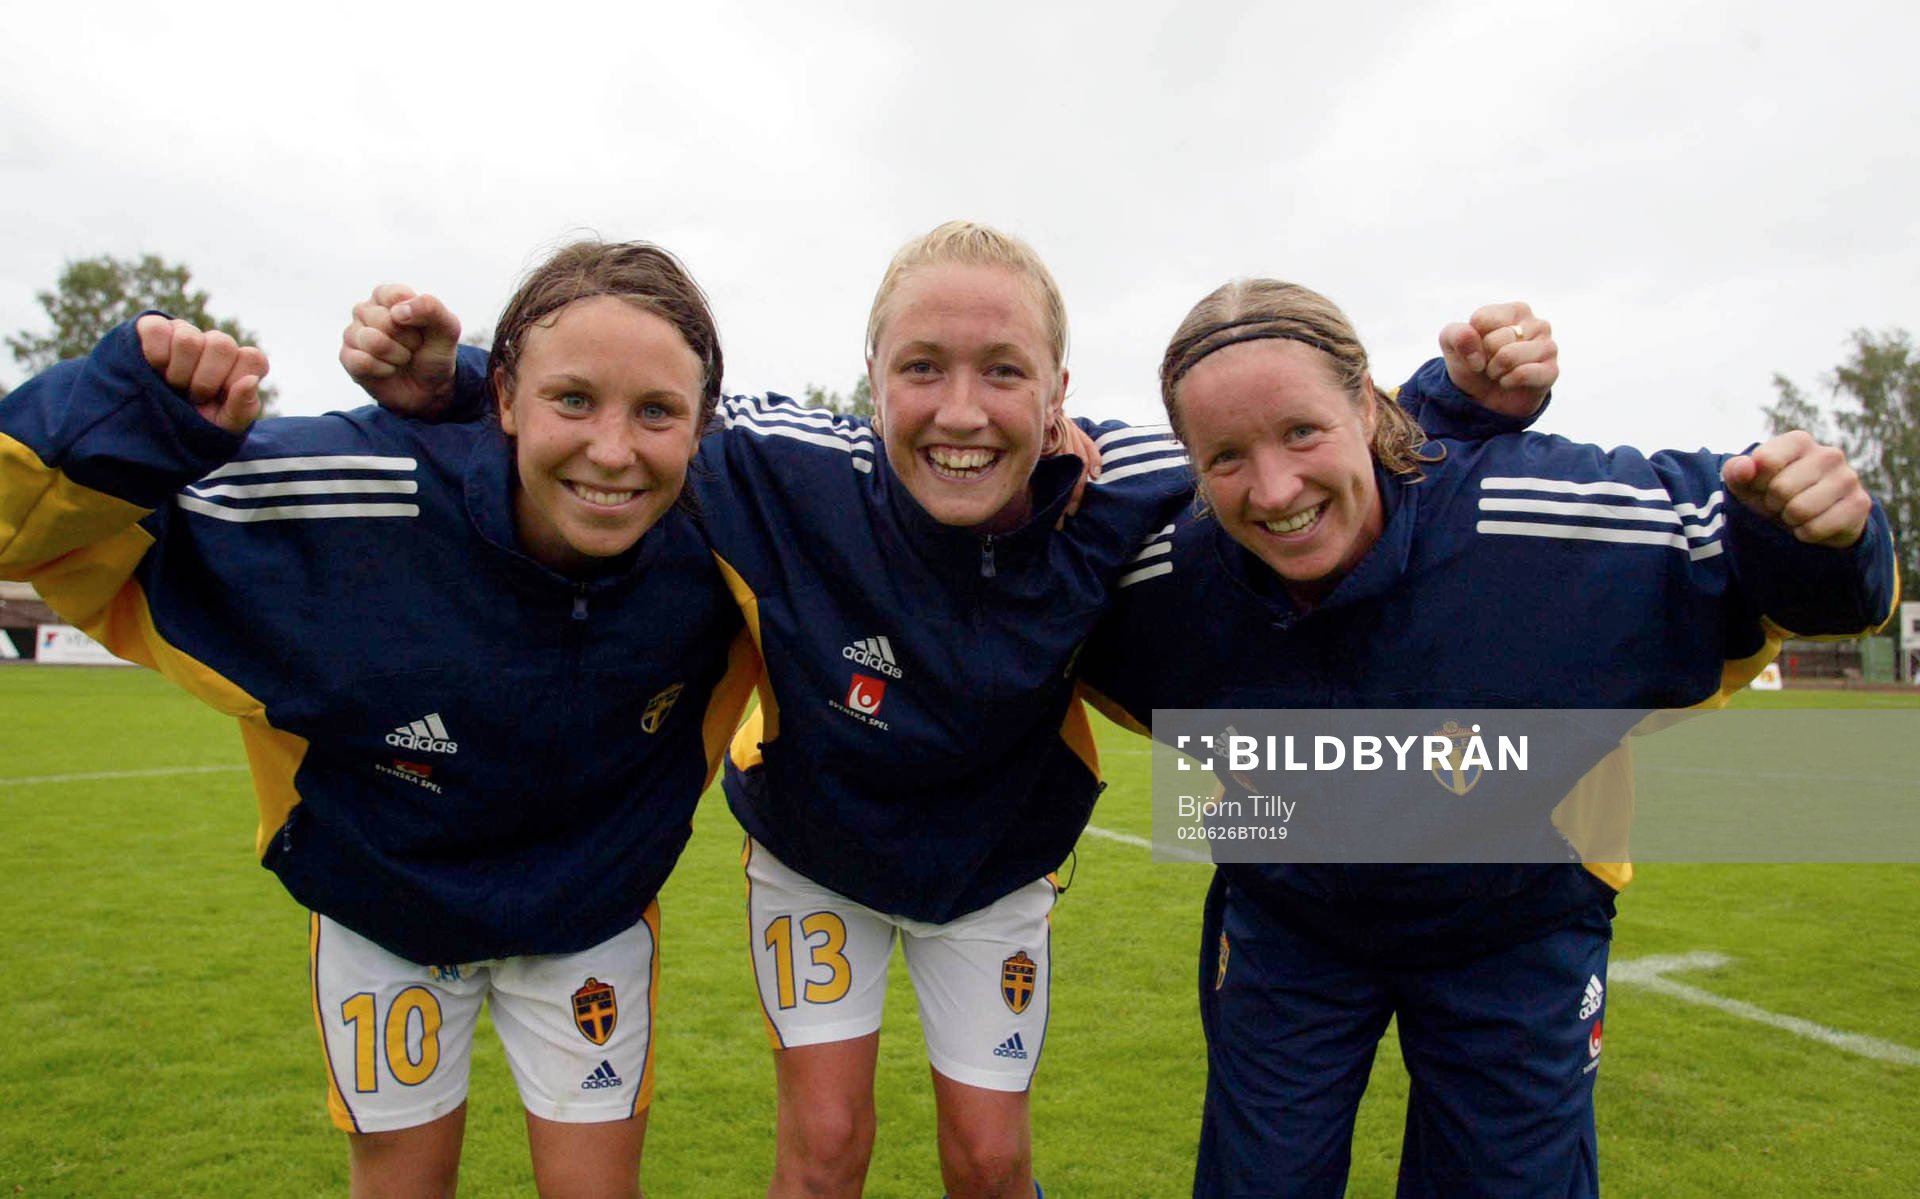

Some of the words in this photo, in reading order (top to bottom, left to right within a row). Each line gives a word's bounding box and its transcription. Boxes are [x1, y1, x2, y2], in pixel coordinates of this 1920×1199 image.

[842, 646, 903, 678] adidas
[385, 733, 458, 754] adidas
[764, 911, 852, 1010] 13
[341, 985, 443, 1093] 10
[581, 1077, 622, 1089] adidas
